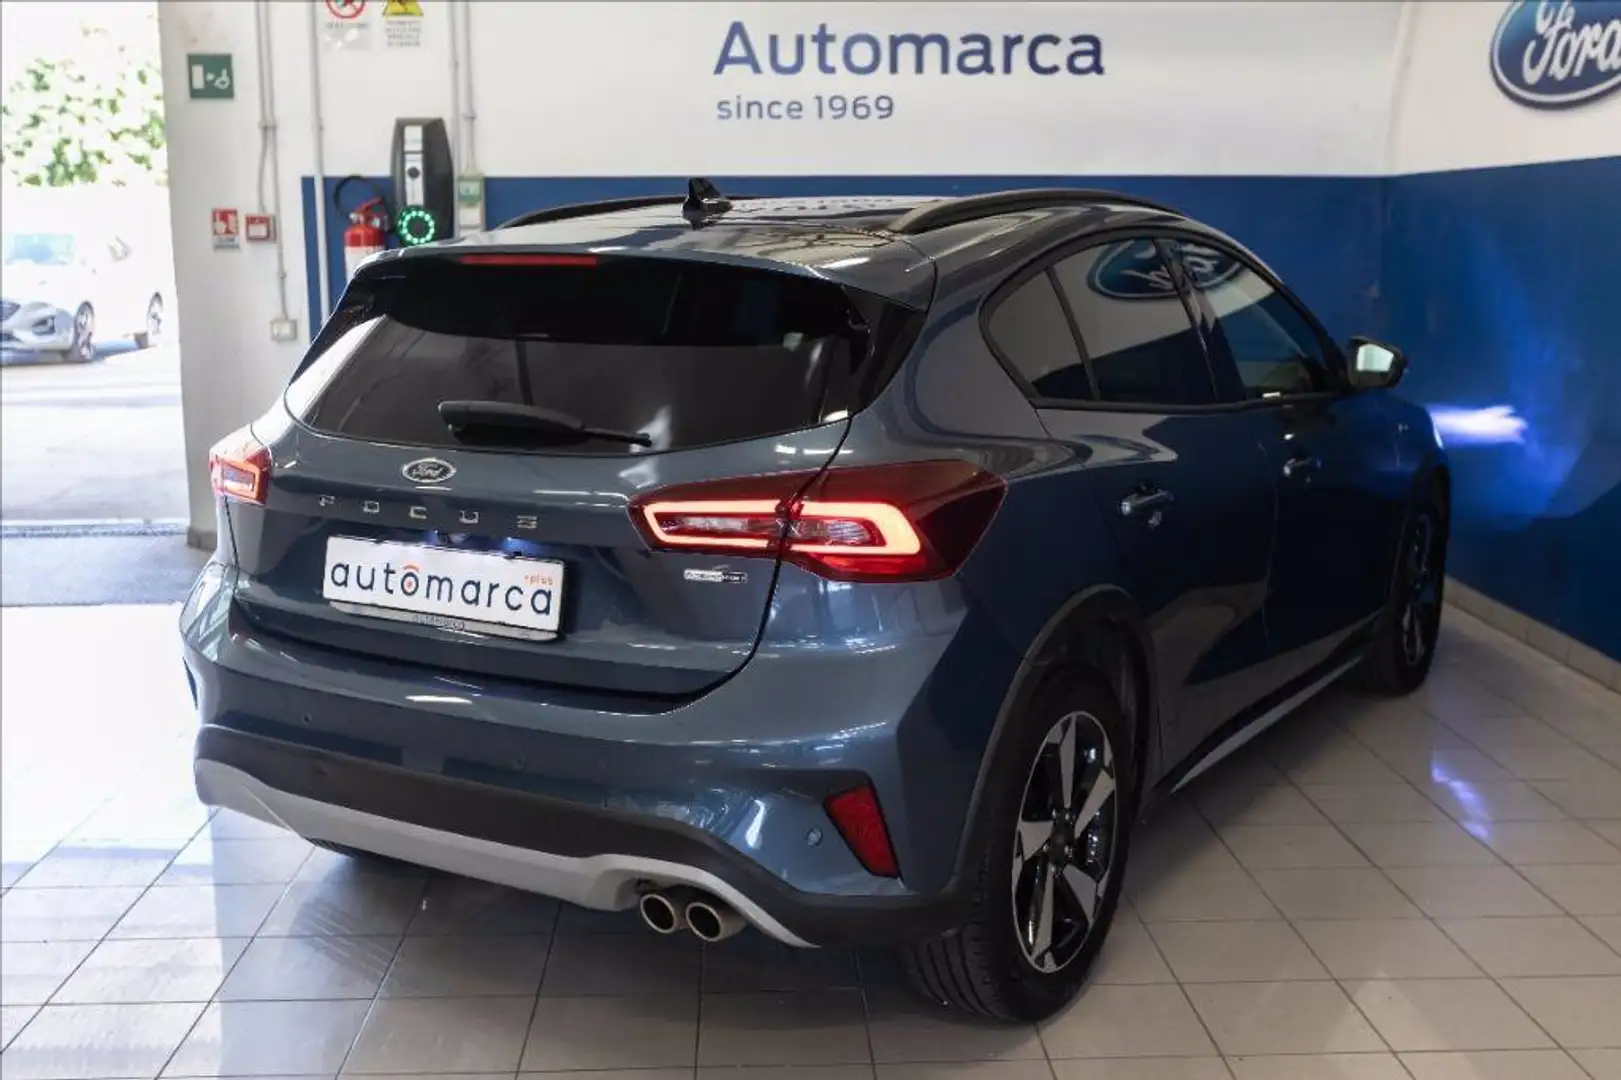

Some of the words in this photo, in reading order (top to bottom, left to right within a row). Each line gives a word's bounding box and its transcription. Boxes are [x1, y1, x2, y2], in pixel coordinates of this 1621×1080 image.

[713, 21, 1105, 76] Automarca
[717, 95, 803, 120] since
[815, 95, 895, 120] 1969
[319, 494, 538, 530] FOCUS
[330, 562, 553, 615] automarca
